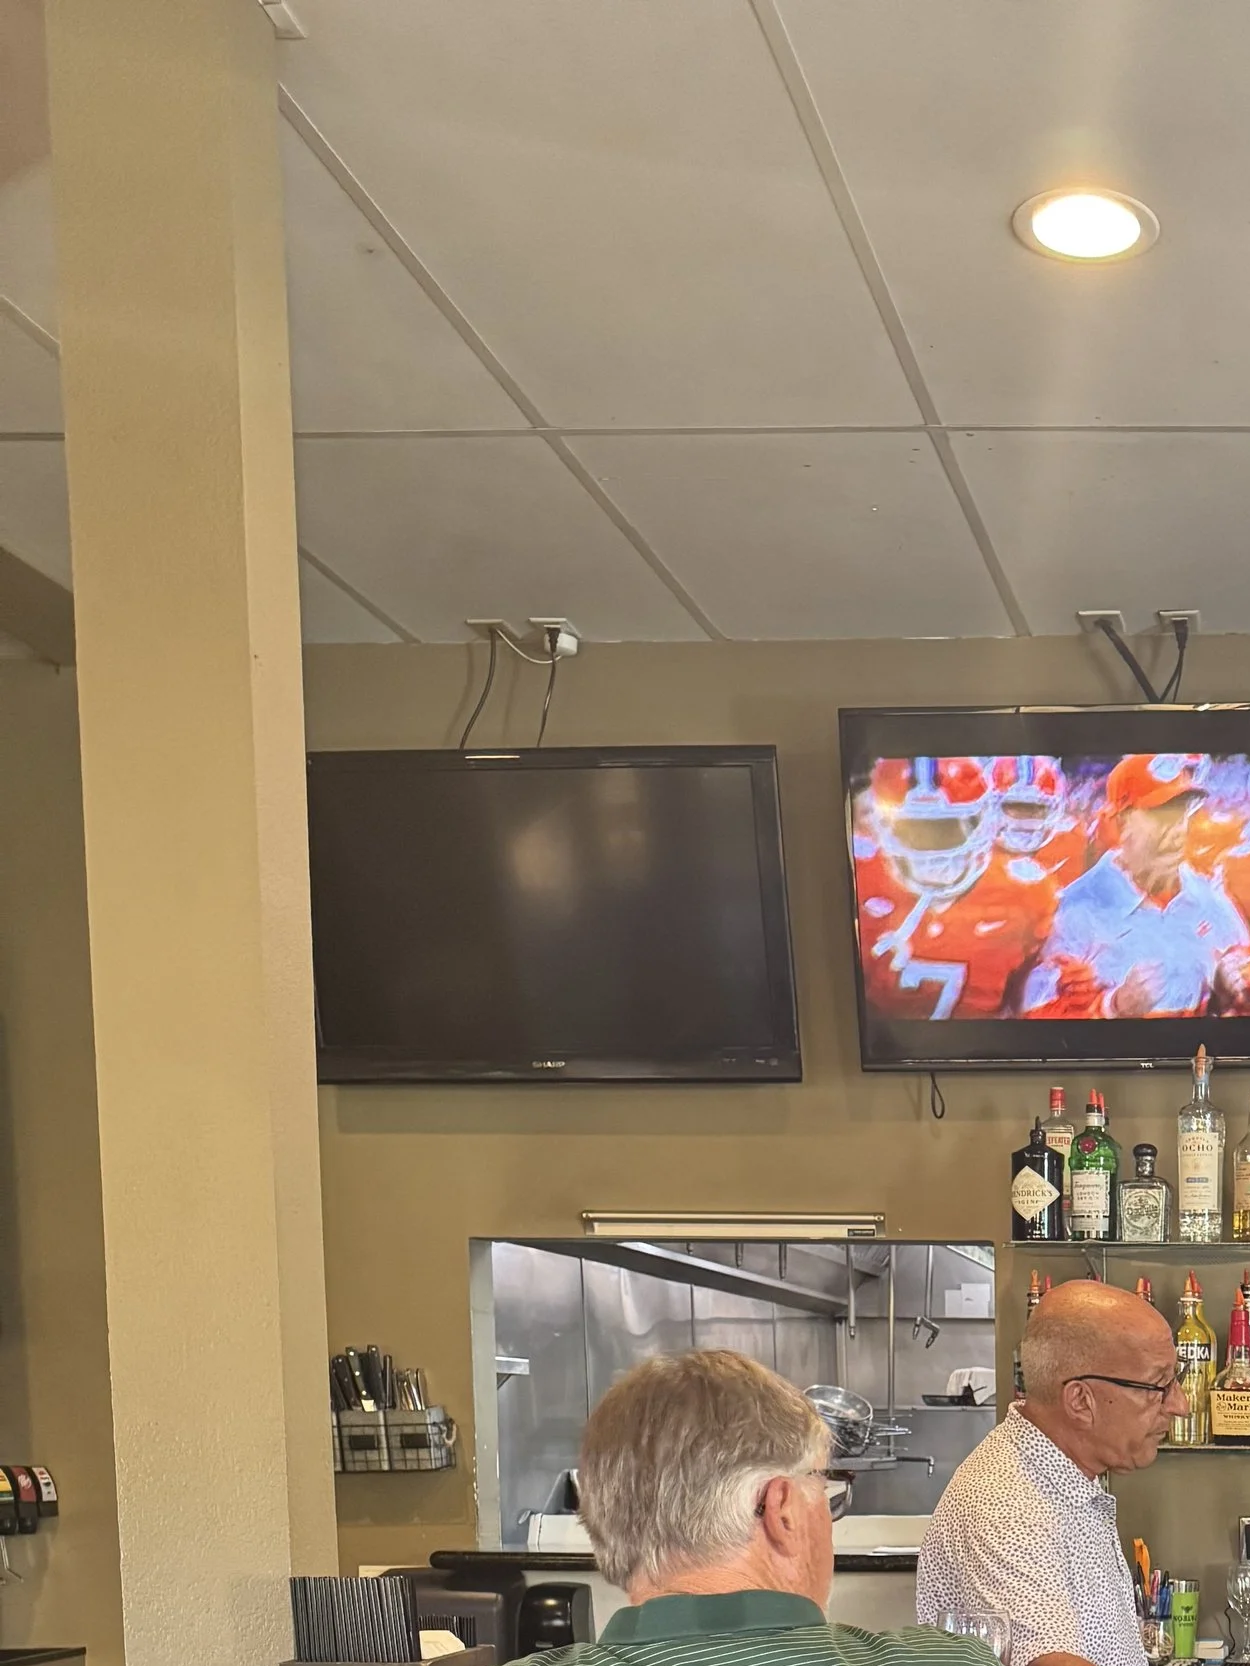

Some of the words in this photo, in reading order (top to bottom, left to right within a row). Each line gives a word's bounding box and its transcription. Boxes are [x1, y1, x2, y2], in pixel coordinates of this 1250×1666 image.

[532, 1060, 566, 1068] SHARP
[1047, 1136, 1071, 1145] EFEATER
[1182, 1144, 1213, 1152] OCHO
[1012, 1189, 1053, 1198] ENDRICK'S
[1175, 1346, 1210, 1359] VEDKA
